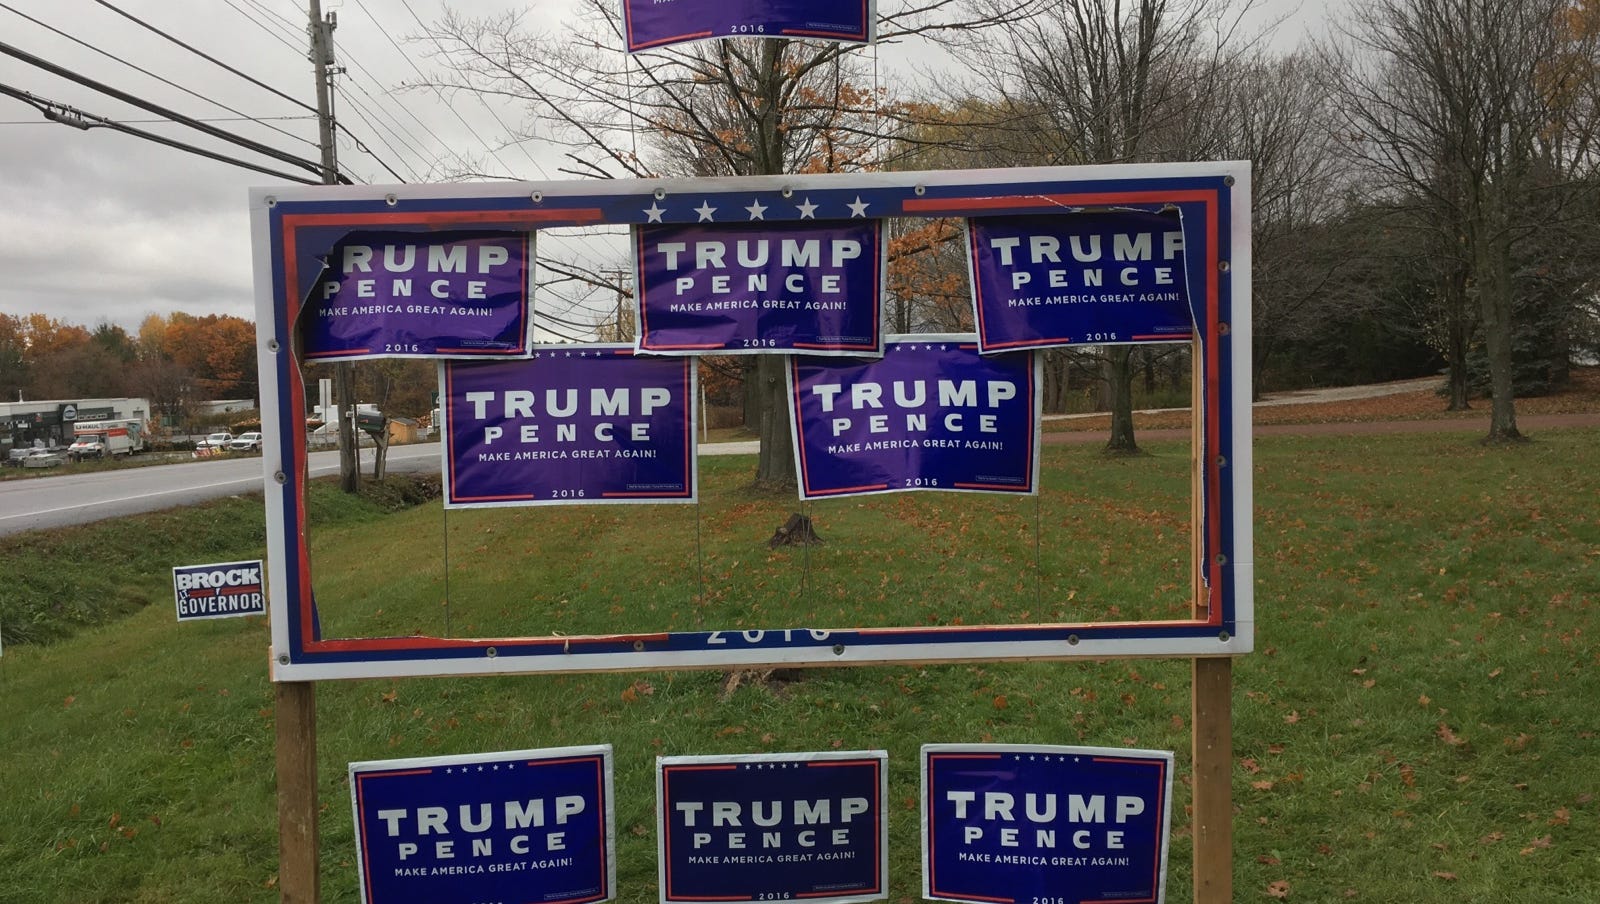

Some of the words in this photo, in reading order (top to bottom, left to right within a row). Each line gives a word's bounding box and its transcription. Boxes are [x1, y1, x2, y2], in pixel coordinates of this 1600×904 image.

[731, 25, 765, 33] 2016
[658, 240, 862, 271] TRUMP
[991, 231, 1184, 266] TRUMP
[343, 245, 509, 273] RUMP
[676, 275, 840, 295] PENCE
[1012, 267, 1173, 290] PENCE
[323, 280, 487, 299] PENCE
[670, 303, 702, 312] MAKE
[706, 301, 758, 310] AMERICA
[763, 301, 800, 309] GREAT
[805, 302, 846, 310] AGAIN!
[1008, 297, 1041, 307] MAKE
[1045, 295, 1097, 305] AMERICA
[1101, 294, 1135, 303] GREAT
[1140, 293, 1179, 301] AGAIN!
[320, 307, 347, 317] MAKE
[352, 305, 402, 315] AMERICA
[407, 305, 445, 315] GREAT
[450, 308, 493, 316] AGAIN!
[743, 339, 775, 347] 2016
[1087, 333, 1117, 341] 2016
[386, 344, 418, 352] 2016
[466, 388, 671, 419] TRUMP
[812, 380, 1017, 412] TRUMP
[484, 423, 650, 444] PENCE
[832, 414, 997, 436] PENCE
[479, 453, 510, 462] MAKE
[515, 451, 567, 460] AMERICA
[572, 450, 610, 458] GREAT
[615, 450, 657, 458] AGAIN!
[828, 444, 860, 454] MAKE
[865, 440, 919, 450] AMERICA
[924, 440, 960, 448] GREAT
[965, 441, 1003, 450] AGAIN!
[906, 478, 937, 486] 2016
[552, 490, 584, 498] 2016
[177, 568, 259, 590] BROCK
[180, 593, 261, 614] GOVERNOR
[378, 796, 586, 836] TRUMP
[676, 797, 869, 826] TRUMP
[947, 791, 1145, 823] TRUMP
[398, 832, 566, 860] PENCE
[694, 829, 849, 849] PENCE
[964, 826, 1124, 849] PENCE
[395, 867, 427, 876] MAKE
[431, 865, 484, 875] AMERICA
[489, 862, 527, 872] GREAT
[531, 858, 572, 869] AGAIN!
[689, 855, 719, 864] MAKE
[723, 855, 773, 864] AMERICA
[777, 854, 813, 862] GREAT
[817, 852, 855, 860] AGAIN!
[959, 852, 990, 862] MAKE
[995, 855, 1047, 865] AMERICA
[1052, 857, 1088, 866] GREAT
[1091, 857, 1129, 866] AGAIN!
[759, 892, 789, 900] 2016
